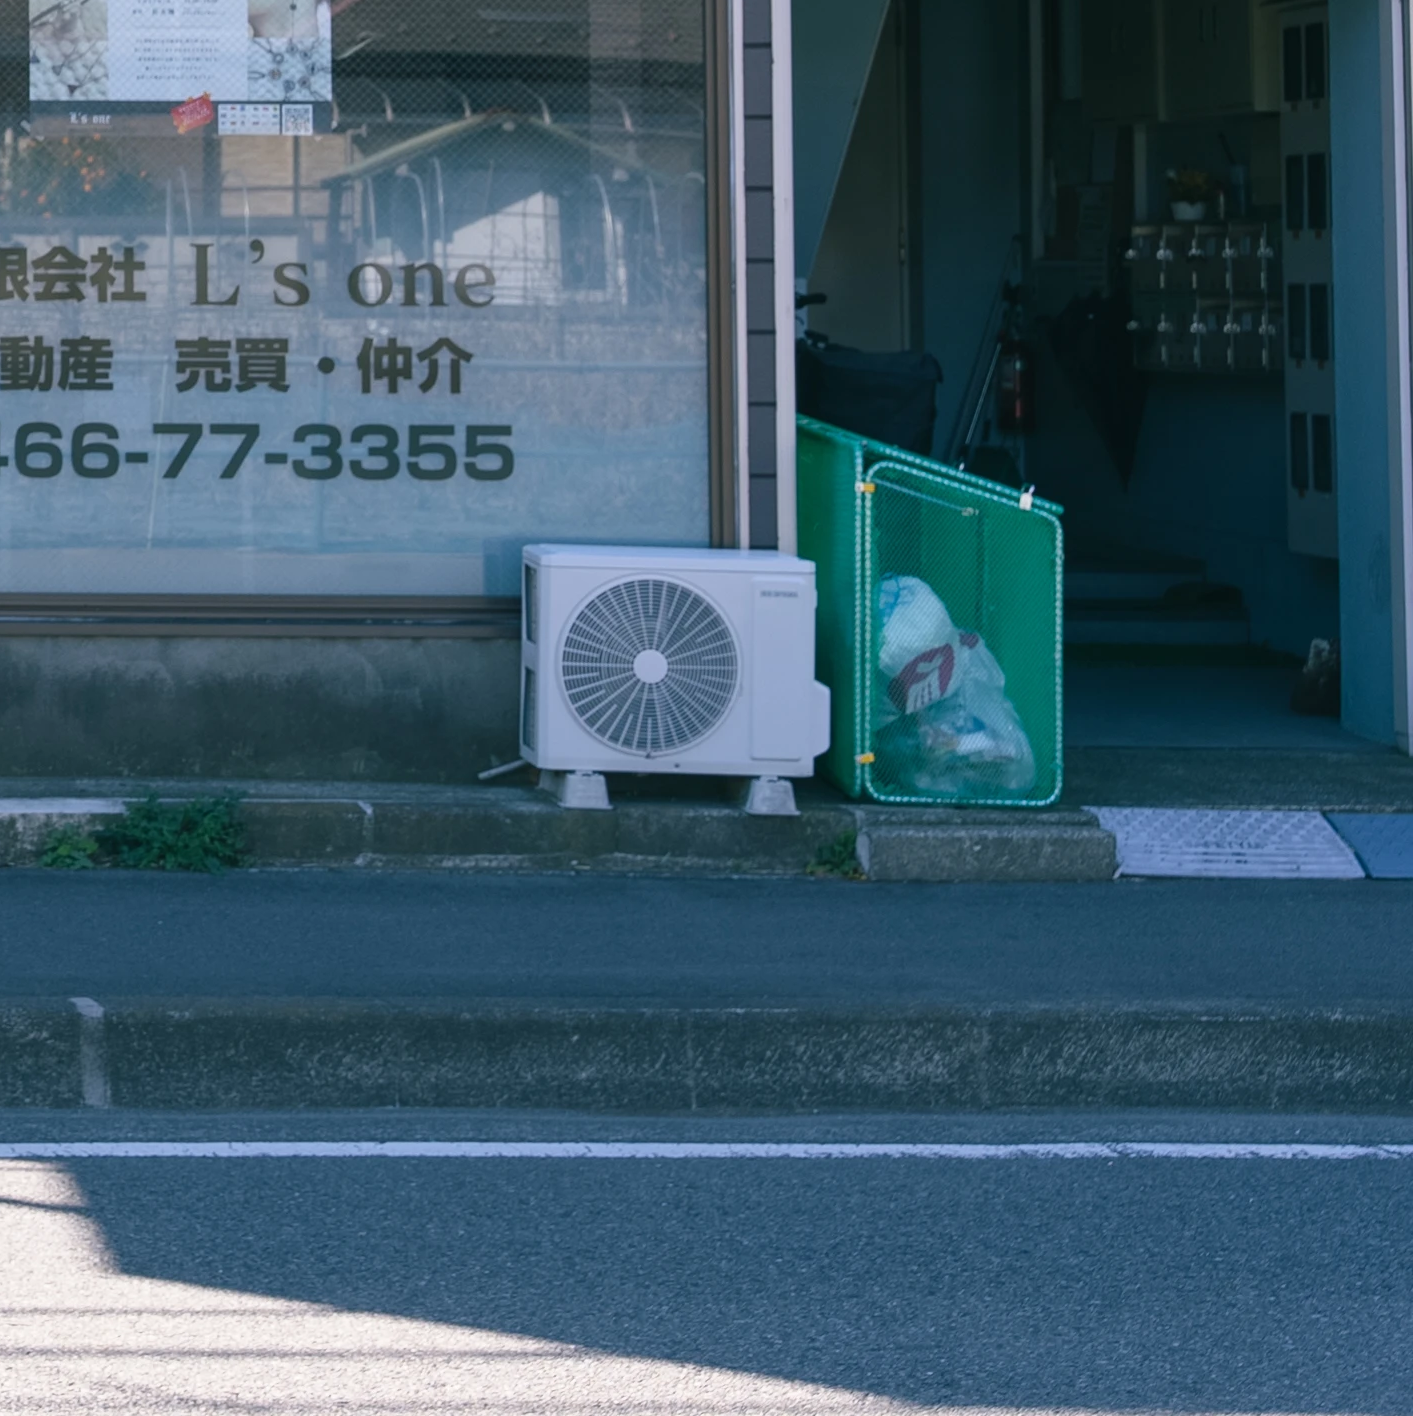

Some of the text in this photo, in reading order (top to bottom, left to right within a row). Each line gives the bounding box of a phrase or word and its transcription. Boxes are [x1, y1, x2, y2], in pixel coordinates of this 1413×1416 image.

[190, 238, 311, 307] L's
[346, 262, 497, 308] one
[174, 336, 474, 395] 売買・仲介
